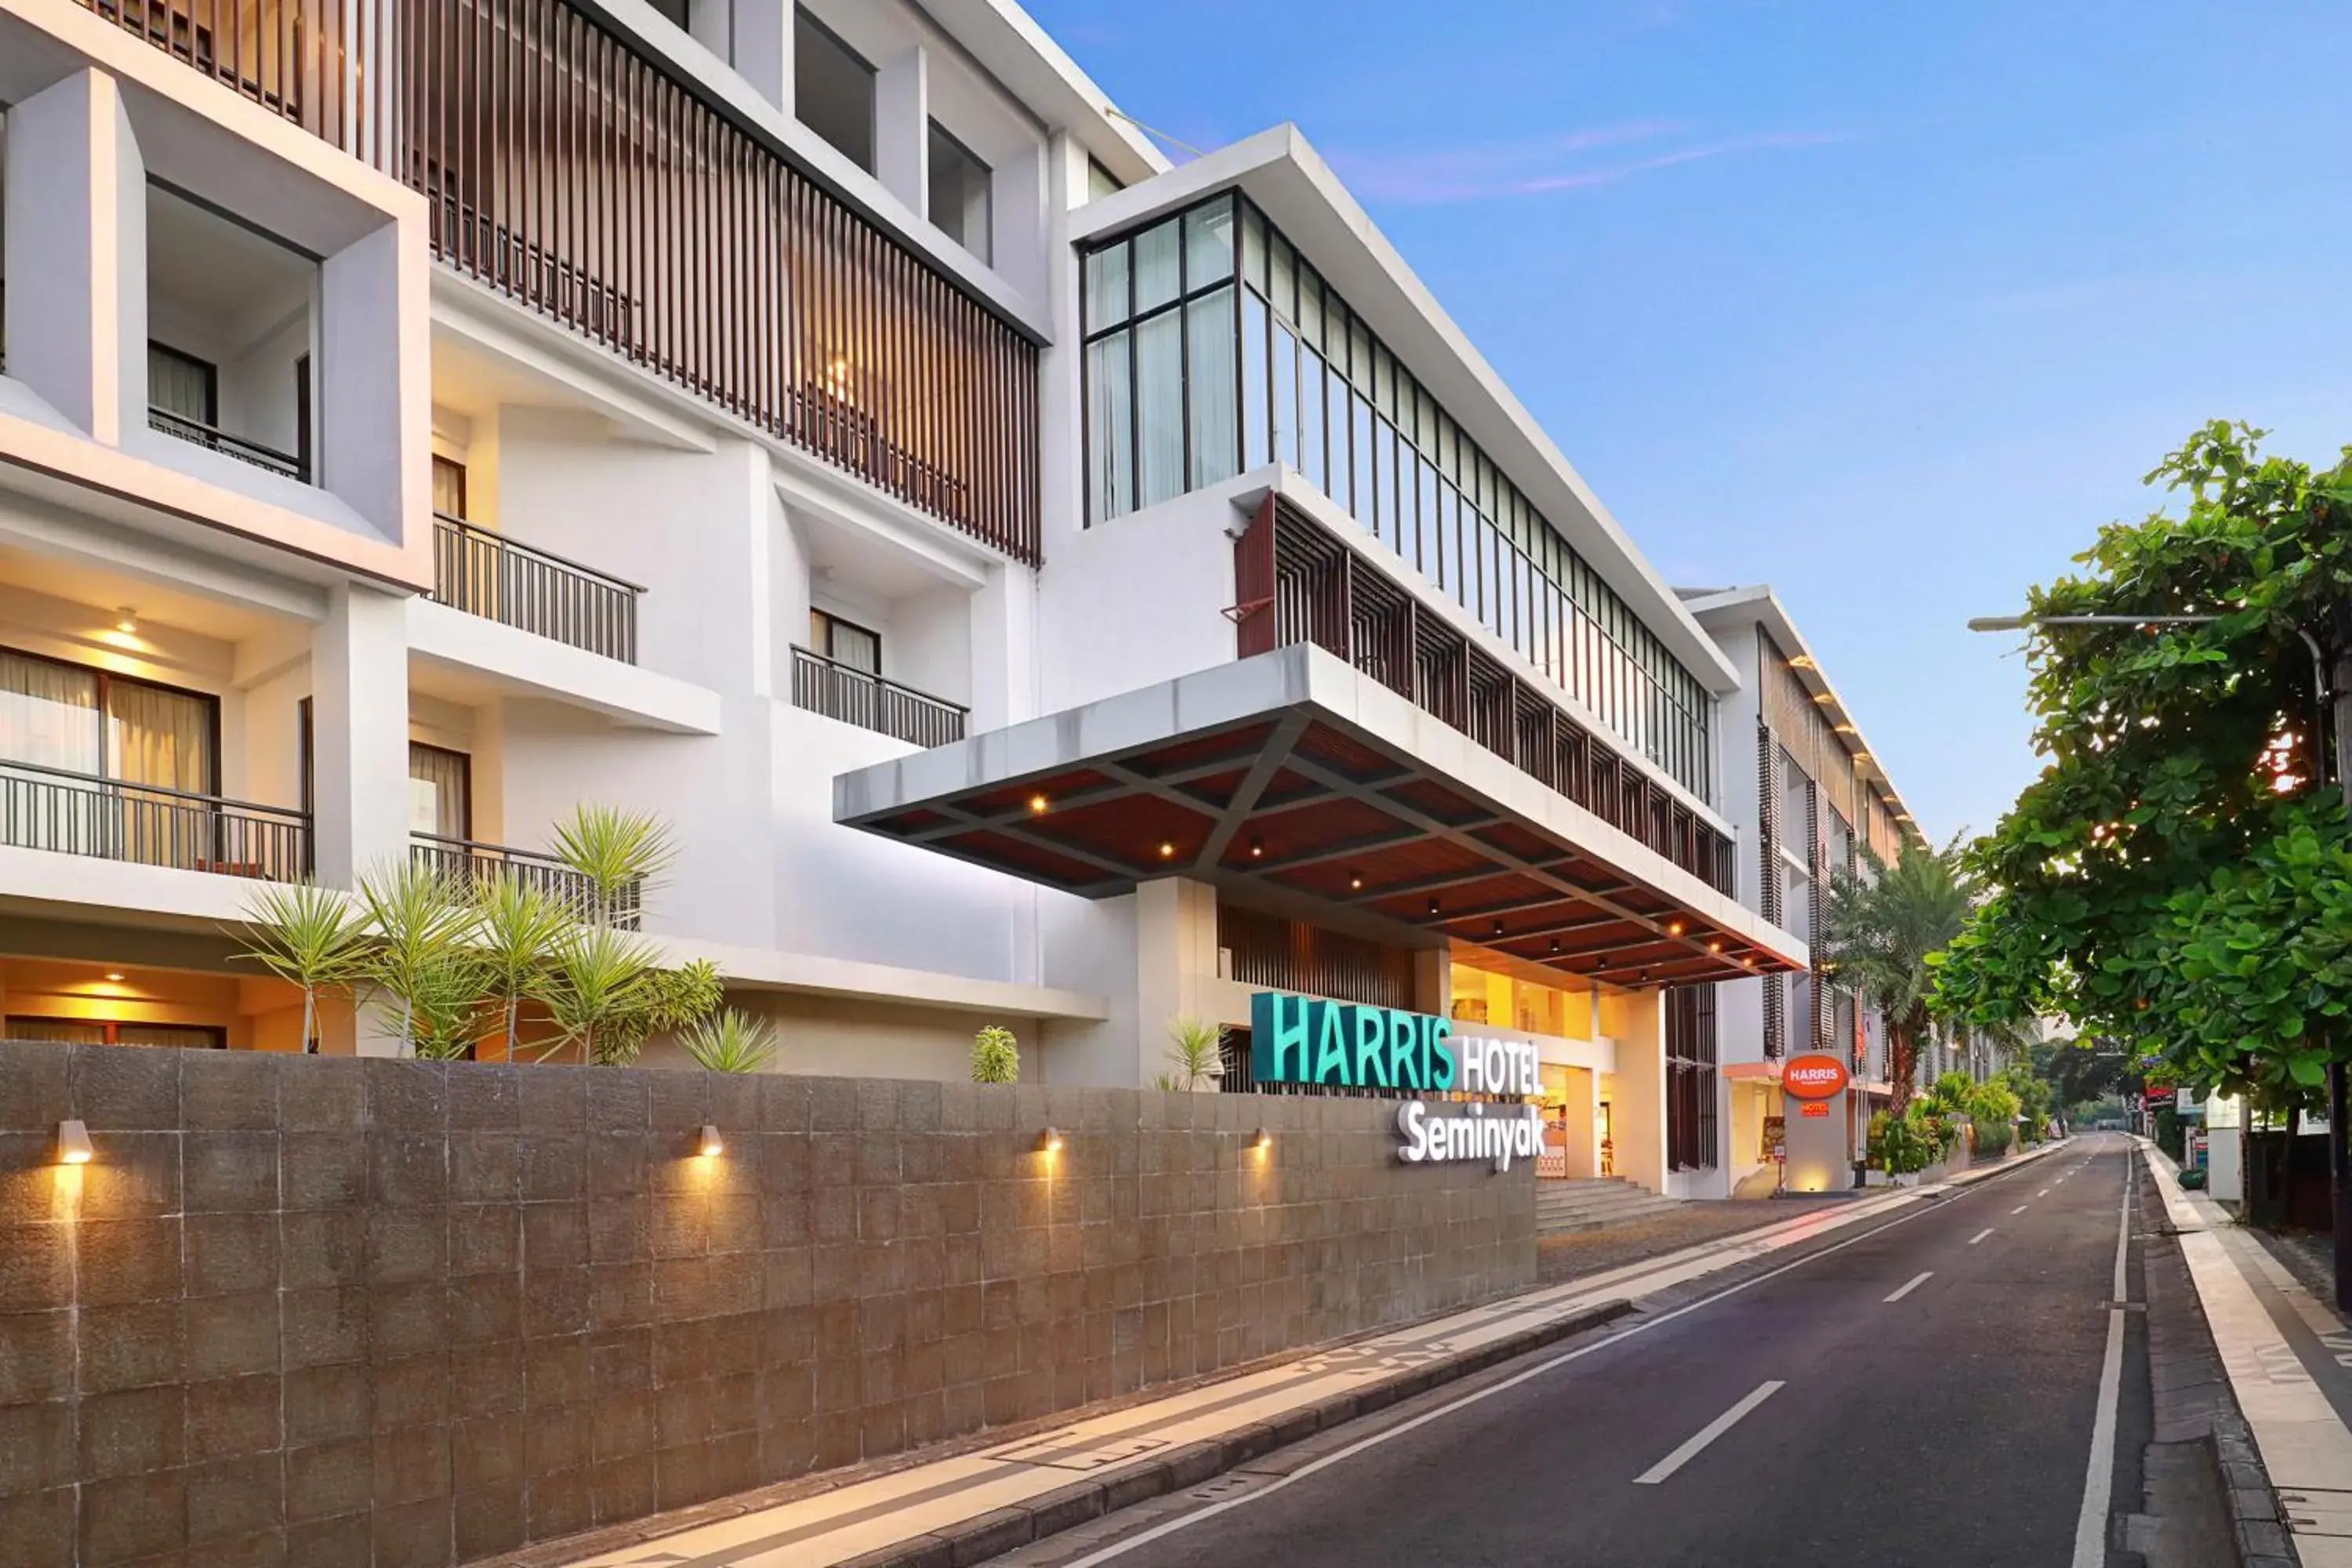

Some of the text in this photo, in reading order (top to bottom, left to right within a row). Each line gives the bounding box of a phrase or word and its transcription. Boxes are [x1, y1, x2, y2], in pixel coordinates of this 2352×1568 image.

[1272, 991, 1544, 1094] HARRIS HOTEL
[1790, 1068, 1838, 1081] HARRIS
[1406, 1101, 1545, 1172] Seminyak
